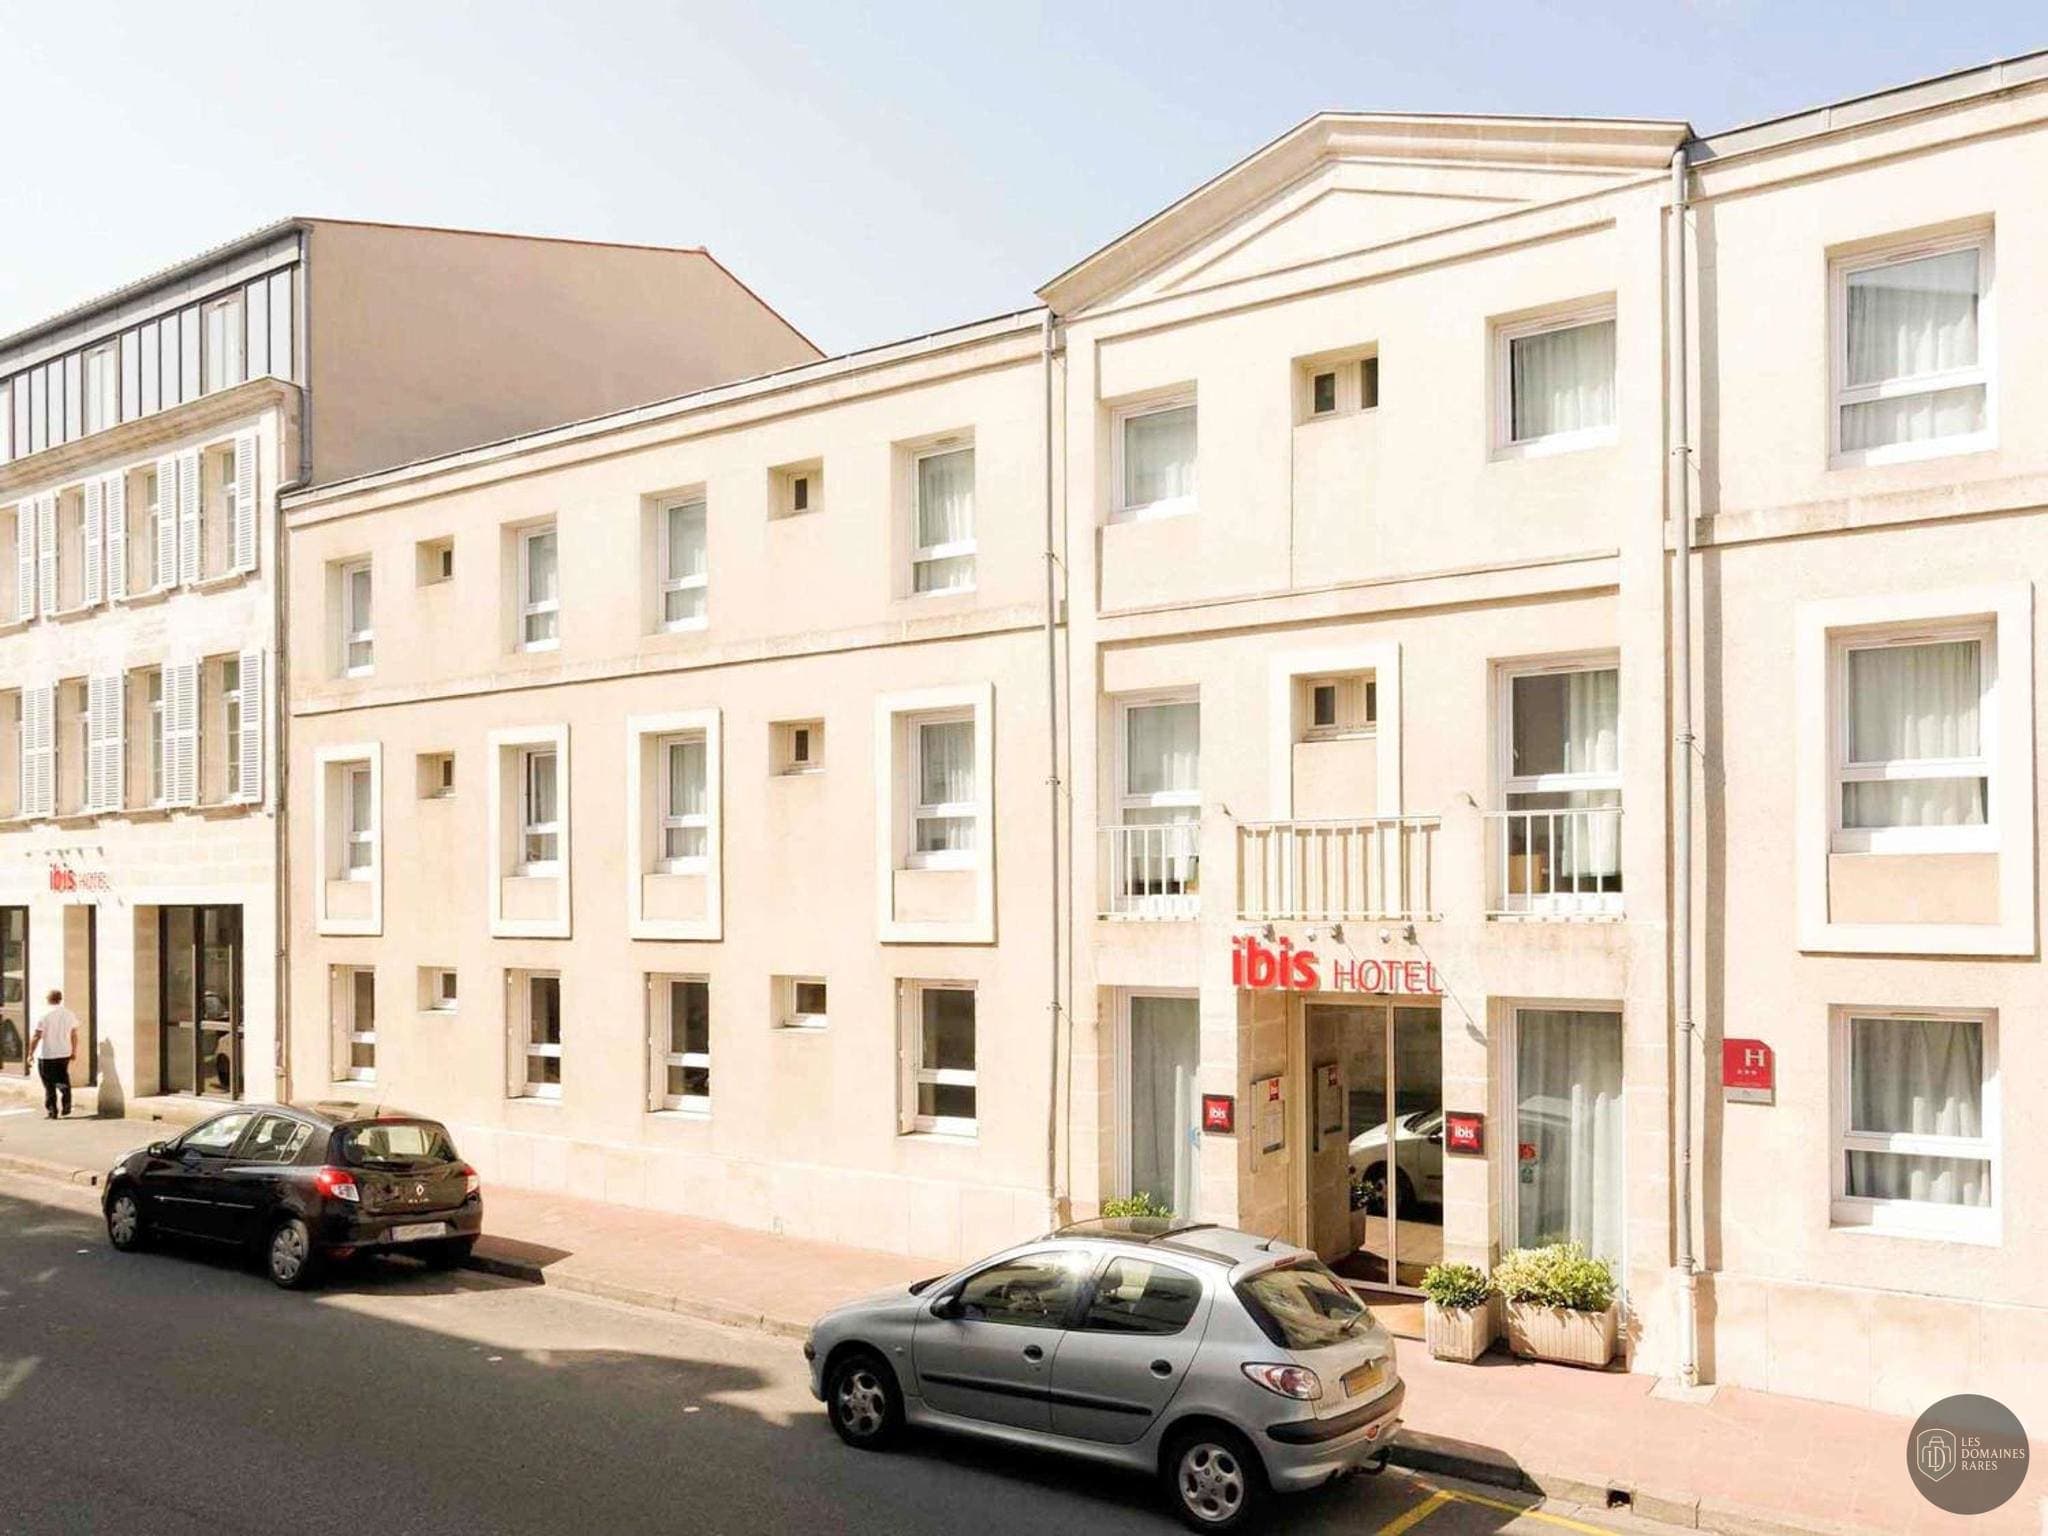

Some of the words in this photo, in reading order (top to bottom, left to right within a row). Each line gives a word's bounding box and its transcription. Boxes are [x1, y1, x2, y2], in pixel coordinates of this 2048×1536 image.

[49, 863, 77, 891] ibis
[1232, 935, 1318, 988] ibis
[1334, 959, 1443, 993] HOTEL
[1745, 1048, 1765, 1067] H
[1209, 1107, 1226, 1119] ibis
[1454, 1125, 1474, 1139] ibis
